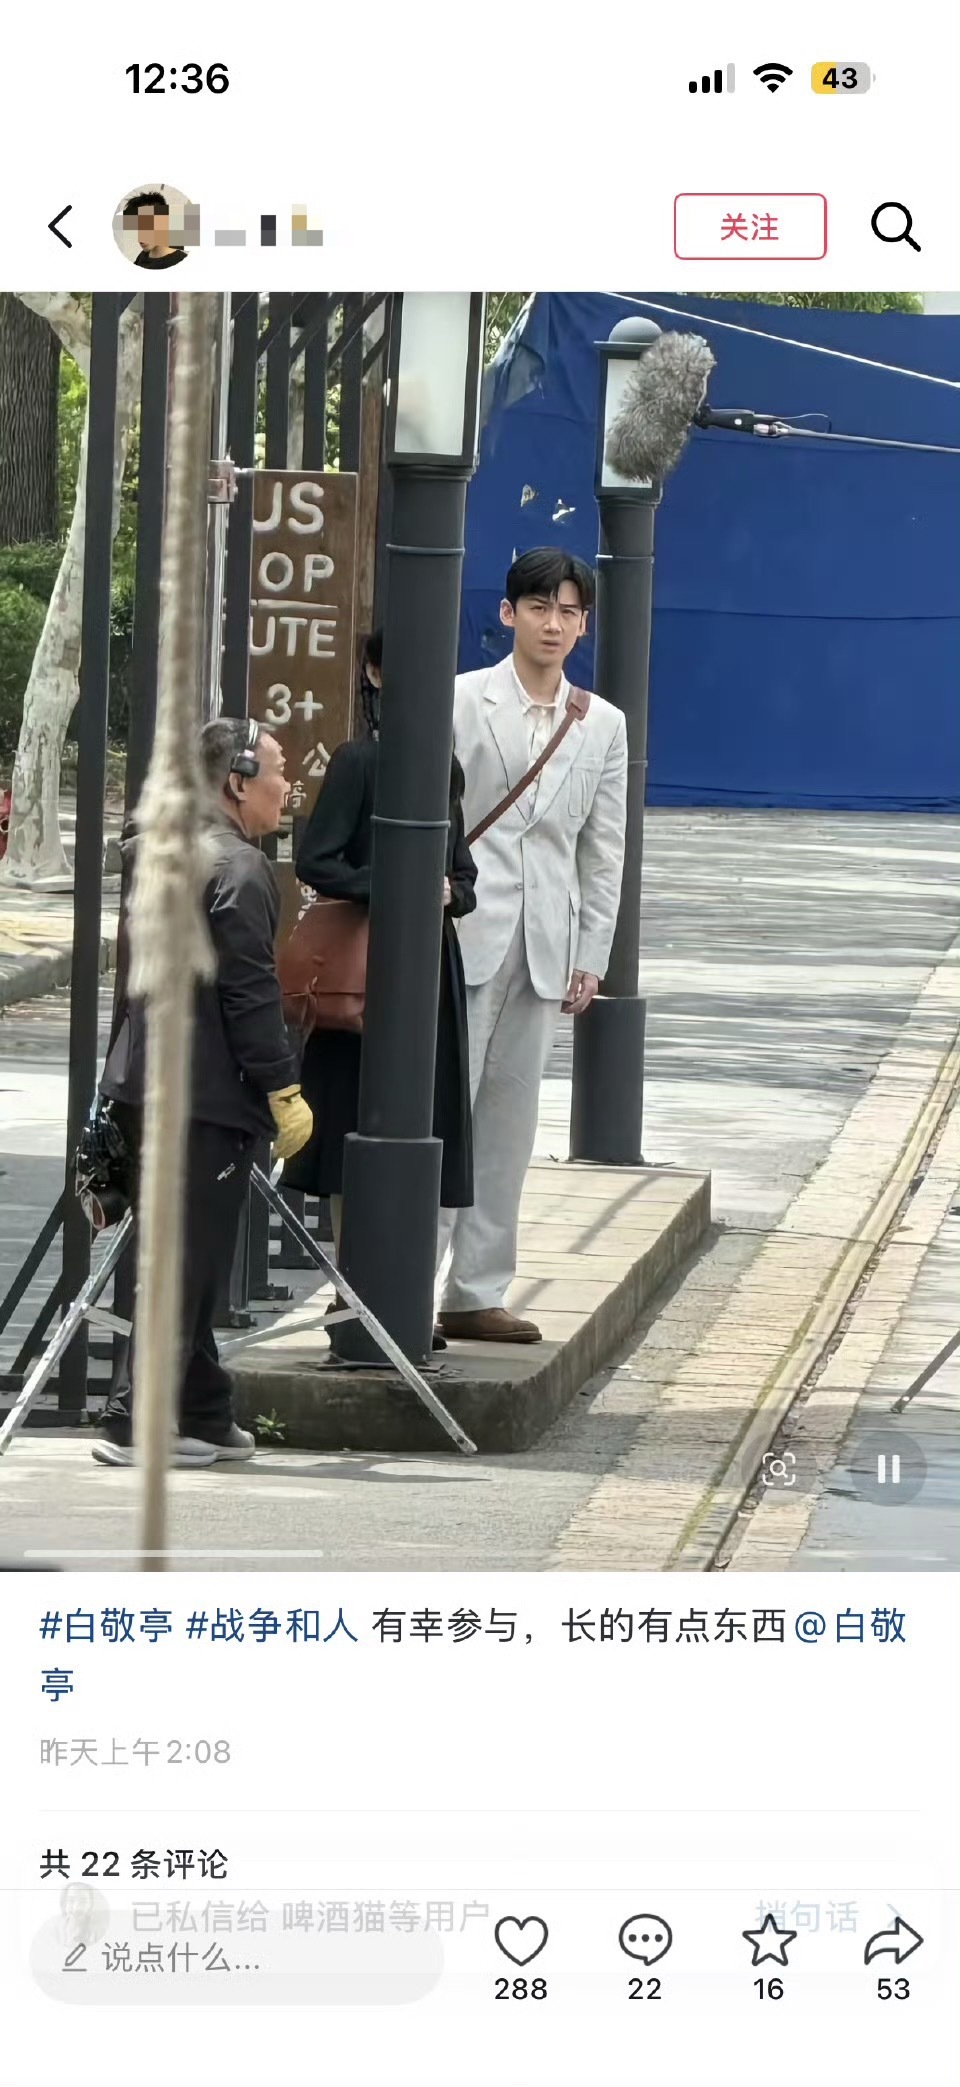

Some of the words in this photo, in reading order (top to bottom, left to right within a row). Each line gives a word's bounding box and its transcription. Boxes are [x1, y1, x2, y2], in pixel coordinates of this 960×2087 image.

[258, 551, 335, 593] OP
[250, 615, 337, 657] UTE
[264, 683, 324, 725] 3+
